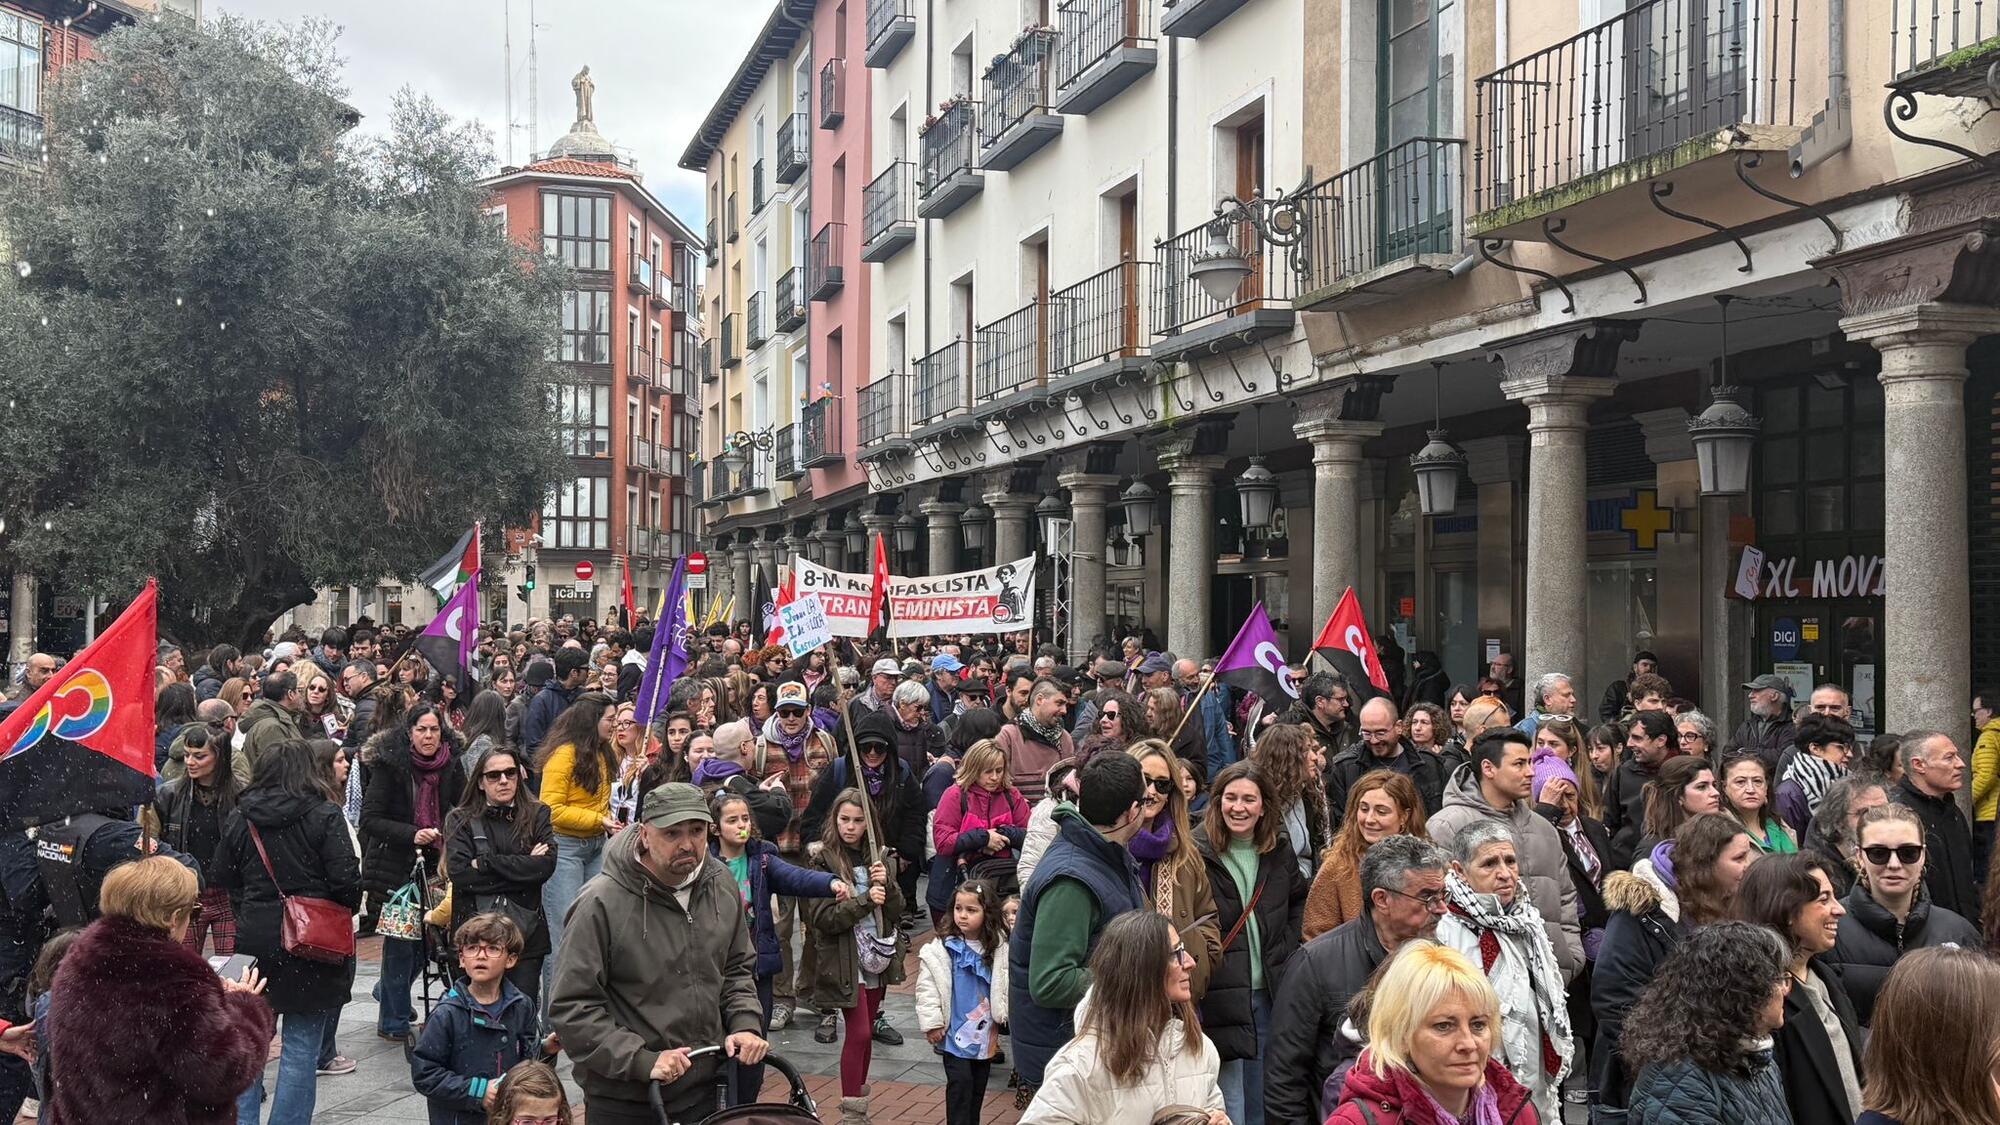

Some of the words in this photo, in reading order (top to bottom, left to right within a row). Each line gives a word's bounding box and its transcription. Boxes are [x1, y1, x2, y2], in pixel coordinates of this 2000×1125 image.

[804, 570, 840, 588] 8-M
[847, 574, 990, 596] ANIFASCISTA
[1766, 556, 1799, 598] XL
[1773, 631, 1796, 643] DIGI
[37, 849, 72, 864] NACIONAL
